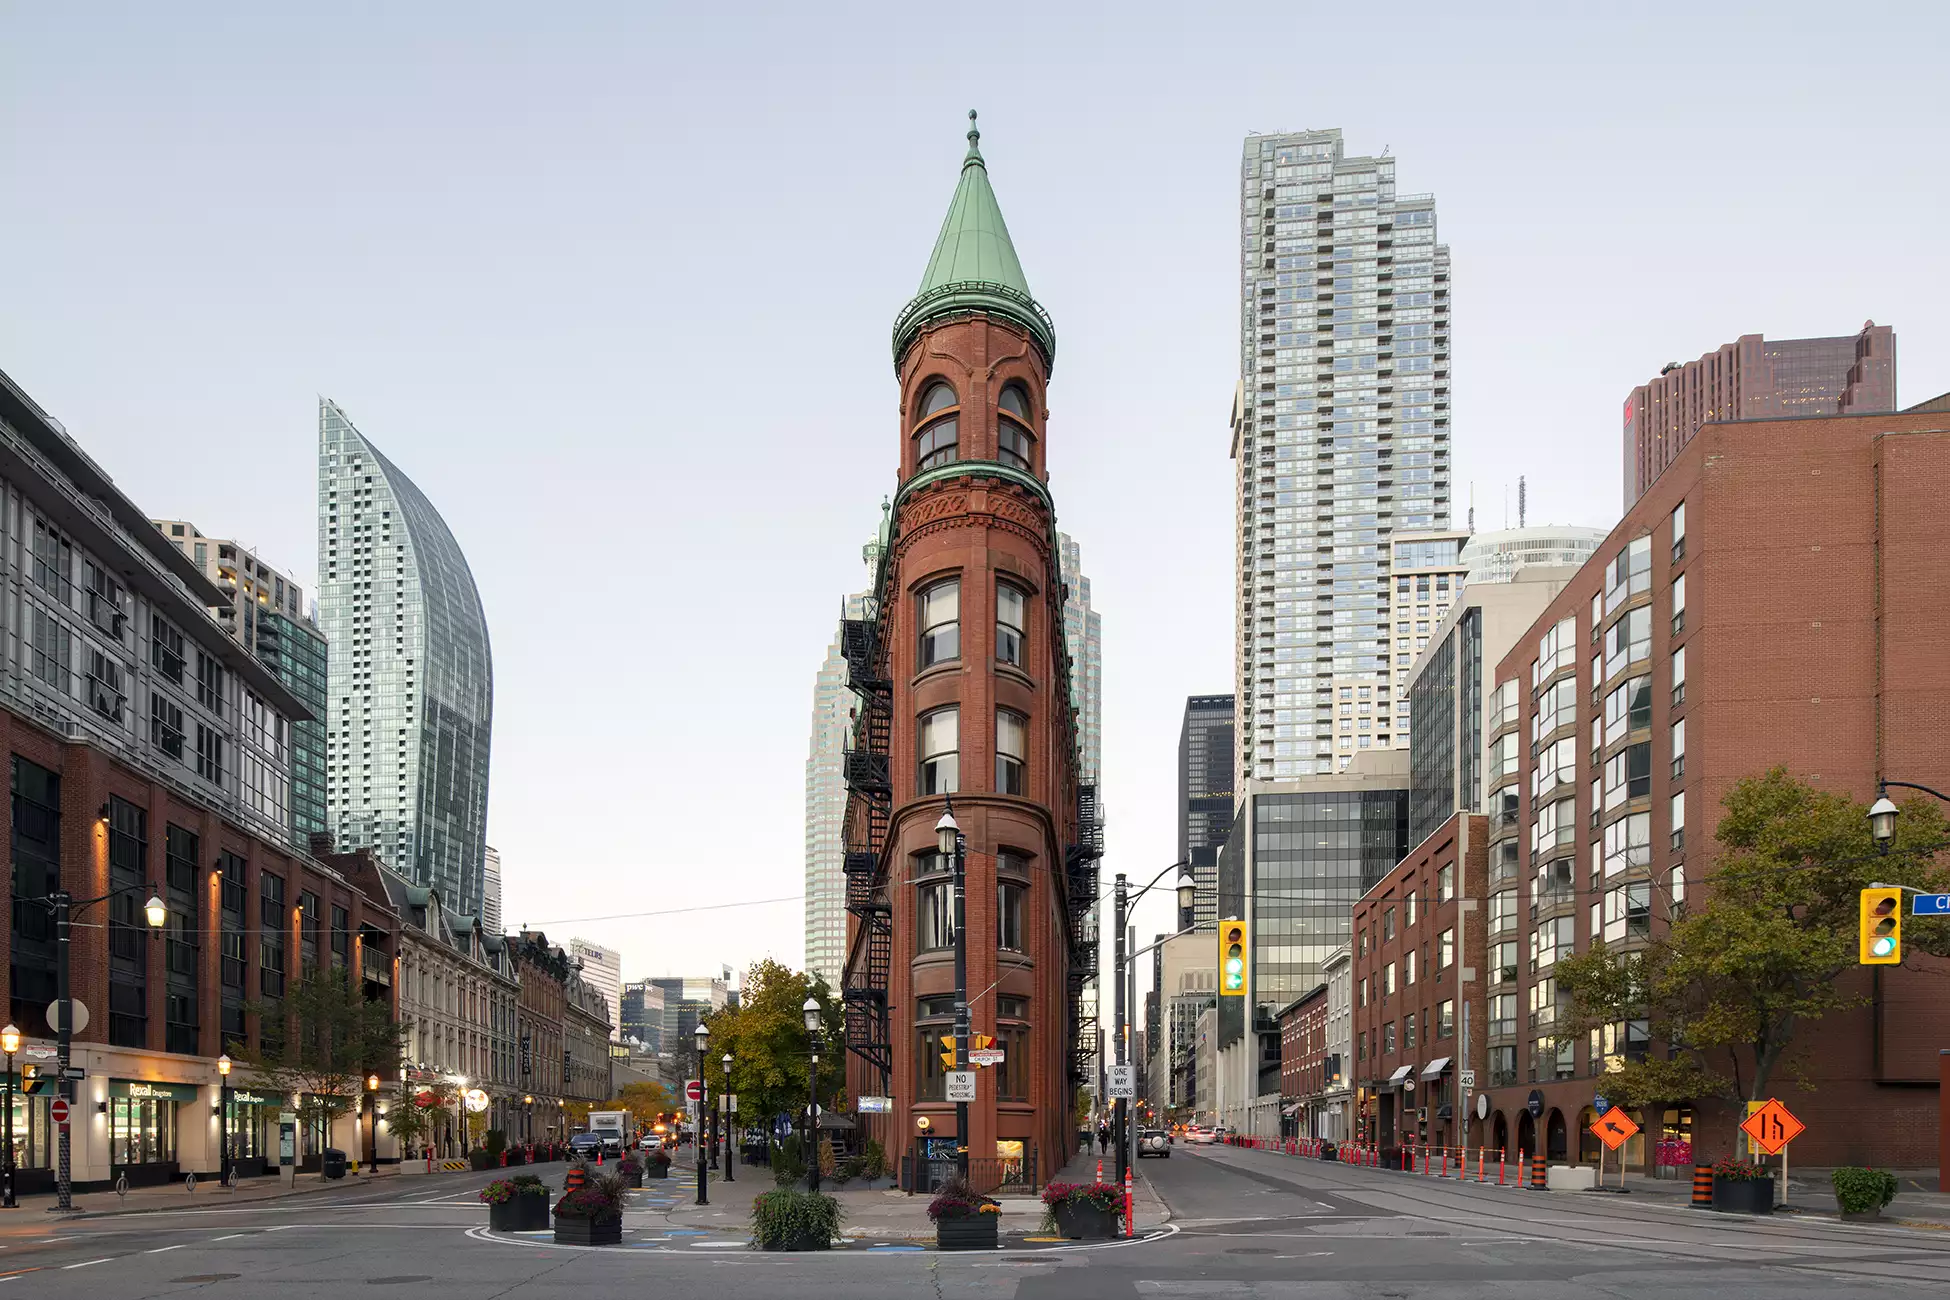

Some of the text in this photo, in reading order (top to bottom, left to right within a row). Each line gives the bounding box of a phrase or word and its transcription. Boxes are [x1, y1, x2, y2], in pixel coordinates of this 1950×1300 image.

[1114, 1068, 1128, 1076] ONE
[956, 1074, 967, 1083] NO
[1461, 1077, 1474, 1085] 40
[129, 1083, 172, 1098] Rexall Drugstore
[233, 1090, 250, 1102] Rexall
